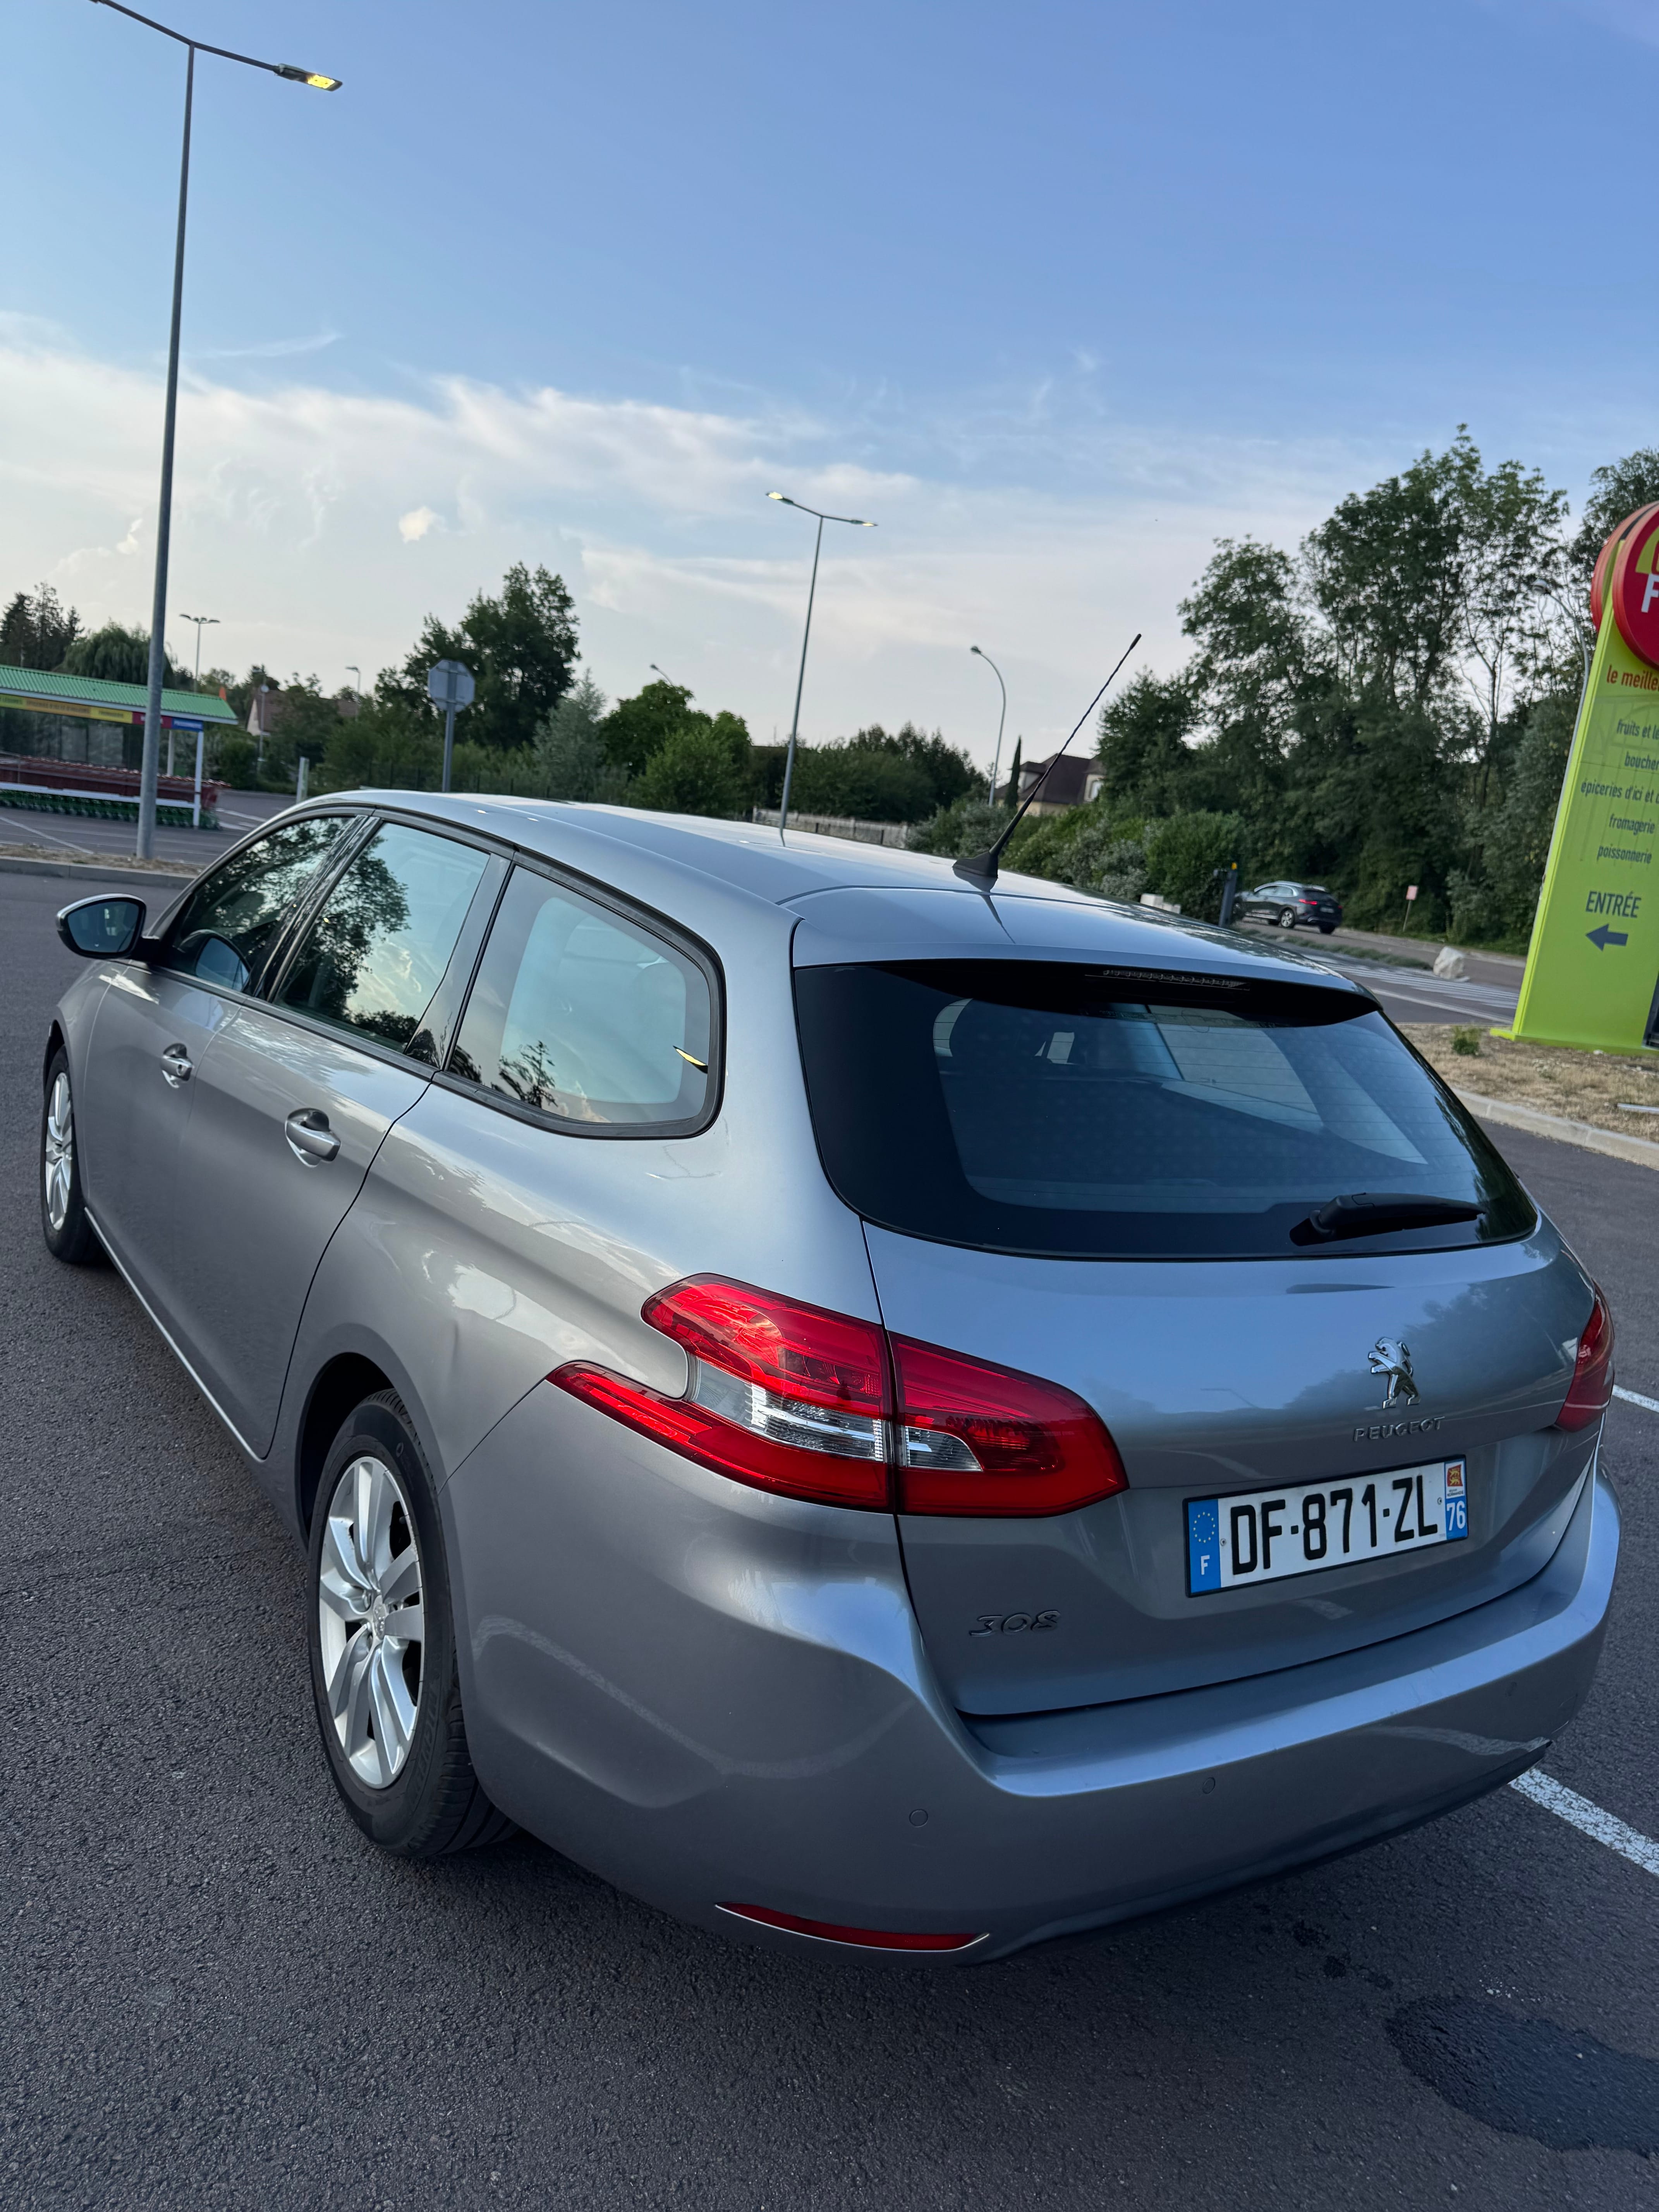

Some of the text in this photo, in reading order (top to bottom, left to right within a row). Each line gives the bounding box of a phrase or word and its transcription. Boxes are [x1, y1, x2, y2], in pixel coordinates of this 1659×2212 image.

[1606, 663, 1659, 692] le meille
[1616, 718, 1640, 737] fruits
[1642, 724, 1651, 738] et
[1581, 778, 1623, 798] épiceries
[1625, 785, 1643, 801] d'ici
[1645, 788, 1654, 803] et
[1609, 813, 1655, 836] fromagerie
[1596, 843, 1652, 864] poissonnerie
[1585, 890, 1642, 918] ENTRÉE
[1353, 1416, 1445, 1441] PEUGEOT
[1446, 1500, 1466, 1531] 76
[1200, 1555, 1210, 1575] F
[969, 1609, 1061, 1637] 308
